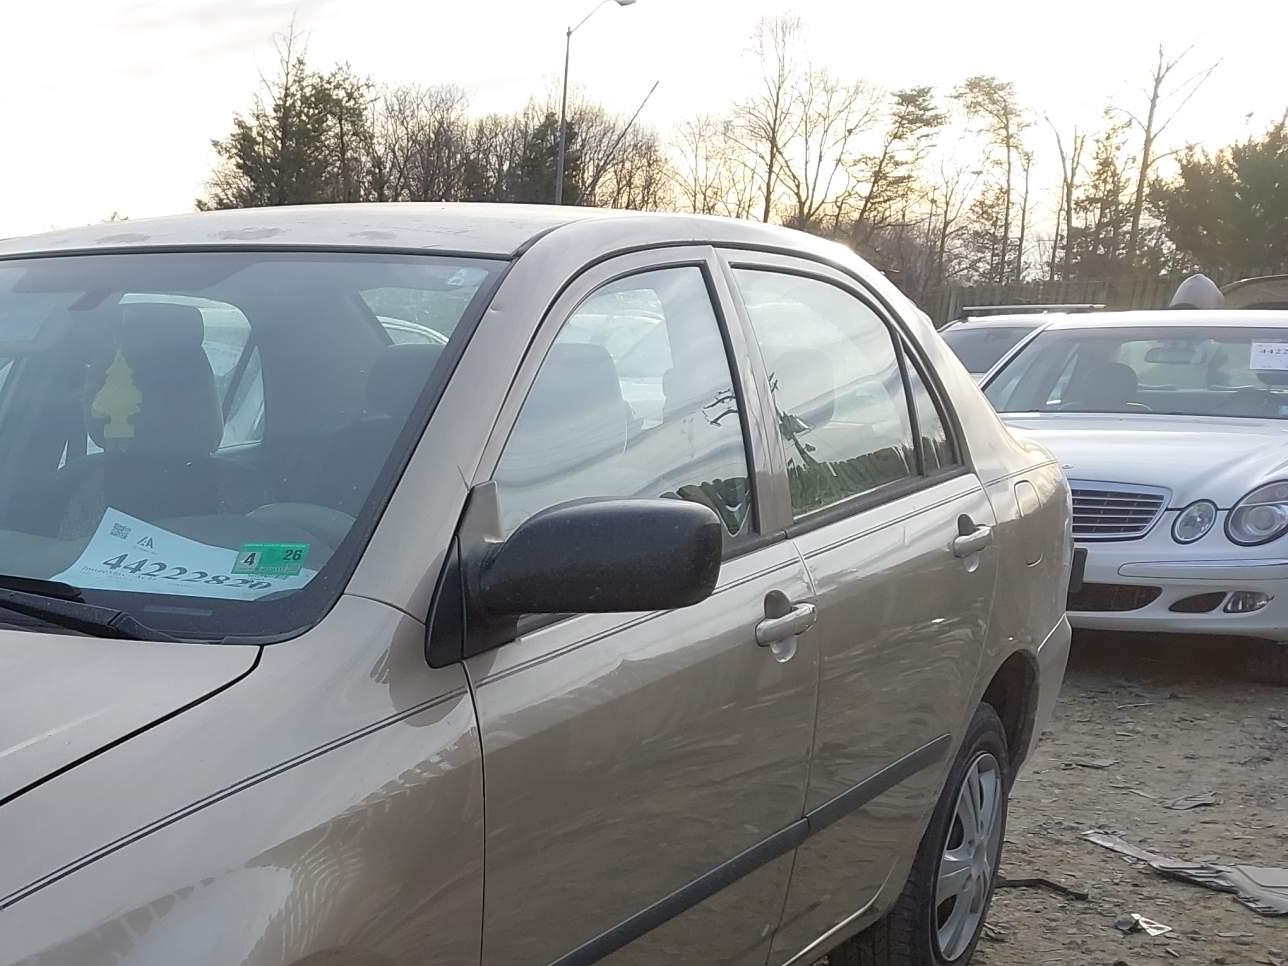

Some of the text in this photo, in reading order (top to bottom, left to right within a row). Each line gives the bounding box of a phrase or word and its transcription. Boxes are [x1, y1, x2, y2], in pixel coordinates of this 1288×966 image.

[243, 549, 303, 566] 4 26
[103, 553, 273, 590] 44222820
